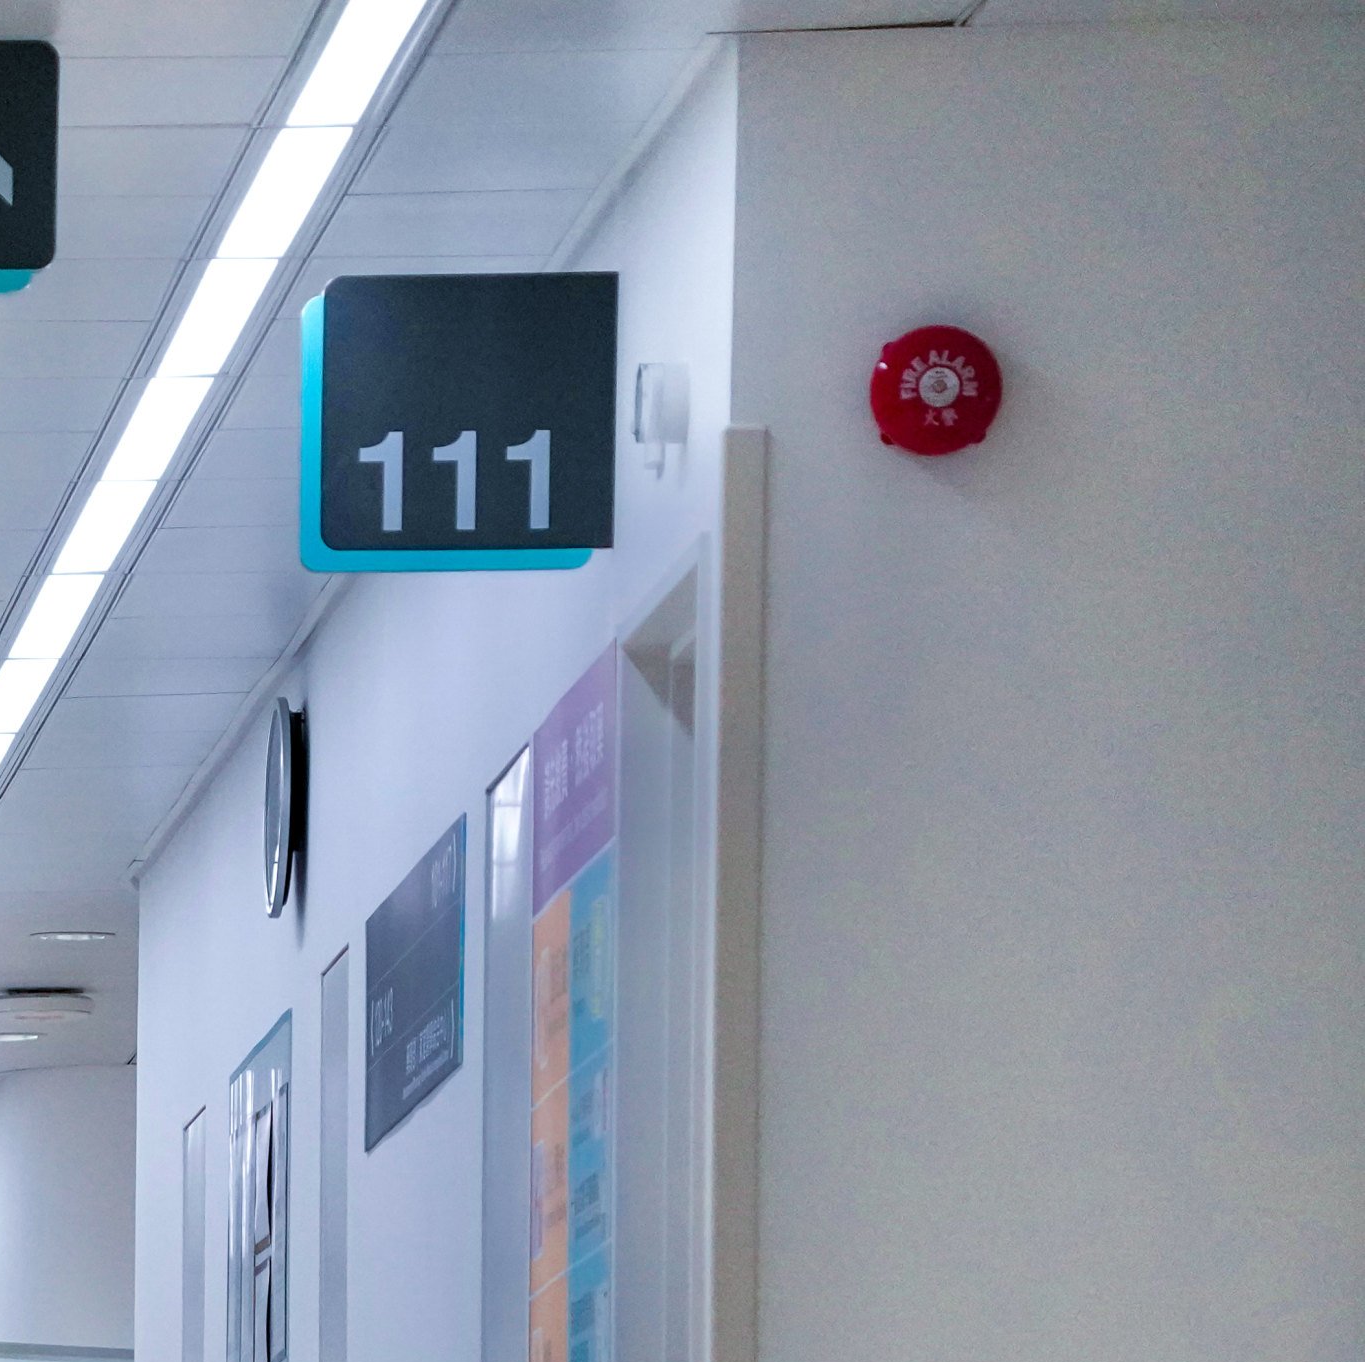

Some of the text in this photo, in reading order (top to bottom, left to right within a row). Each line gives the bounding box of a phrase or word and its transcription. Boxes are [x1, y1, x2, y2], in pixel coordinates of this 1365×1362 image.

[900, 350, 979, 400] FIRE ALARM
[359, 430, 551, 531] 111
